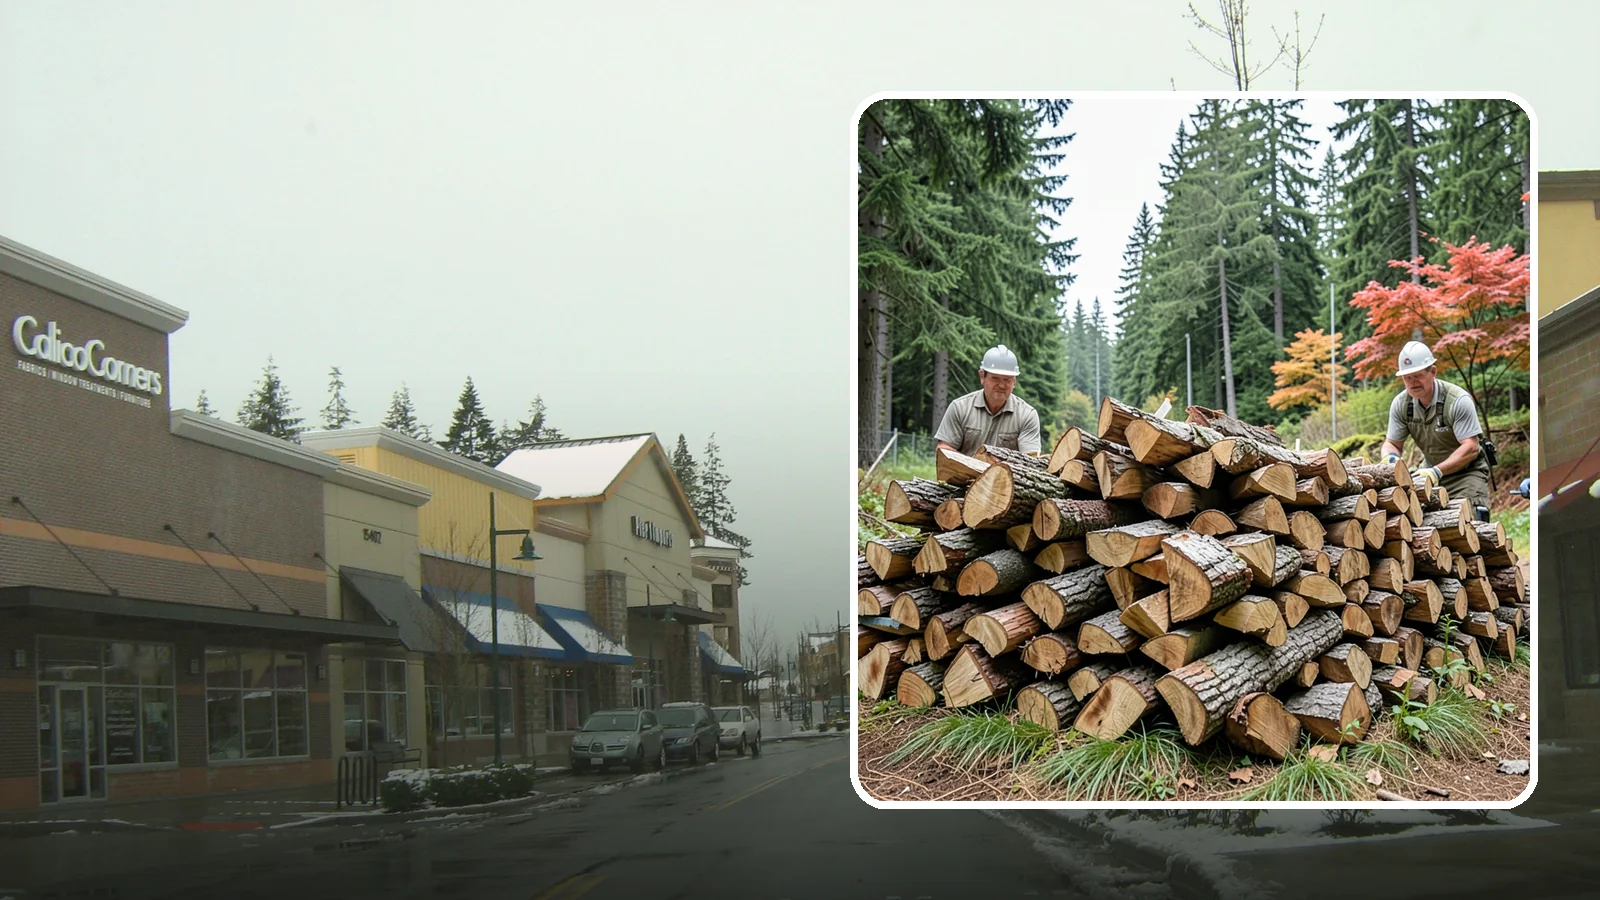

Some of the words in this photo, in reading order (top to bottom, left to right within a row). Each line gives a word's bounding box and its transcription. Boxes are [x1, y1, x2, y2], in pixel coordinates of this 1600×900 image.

[17, 360, 47, 378] FABRICS
[51, 370, 78, 387] WINDOW
[79, 378, 117, 398] TREATMENTS
[120, 391, 151, 409] FURNITURE
